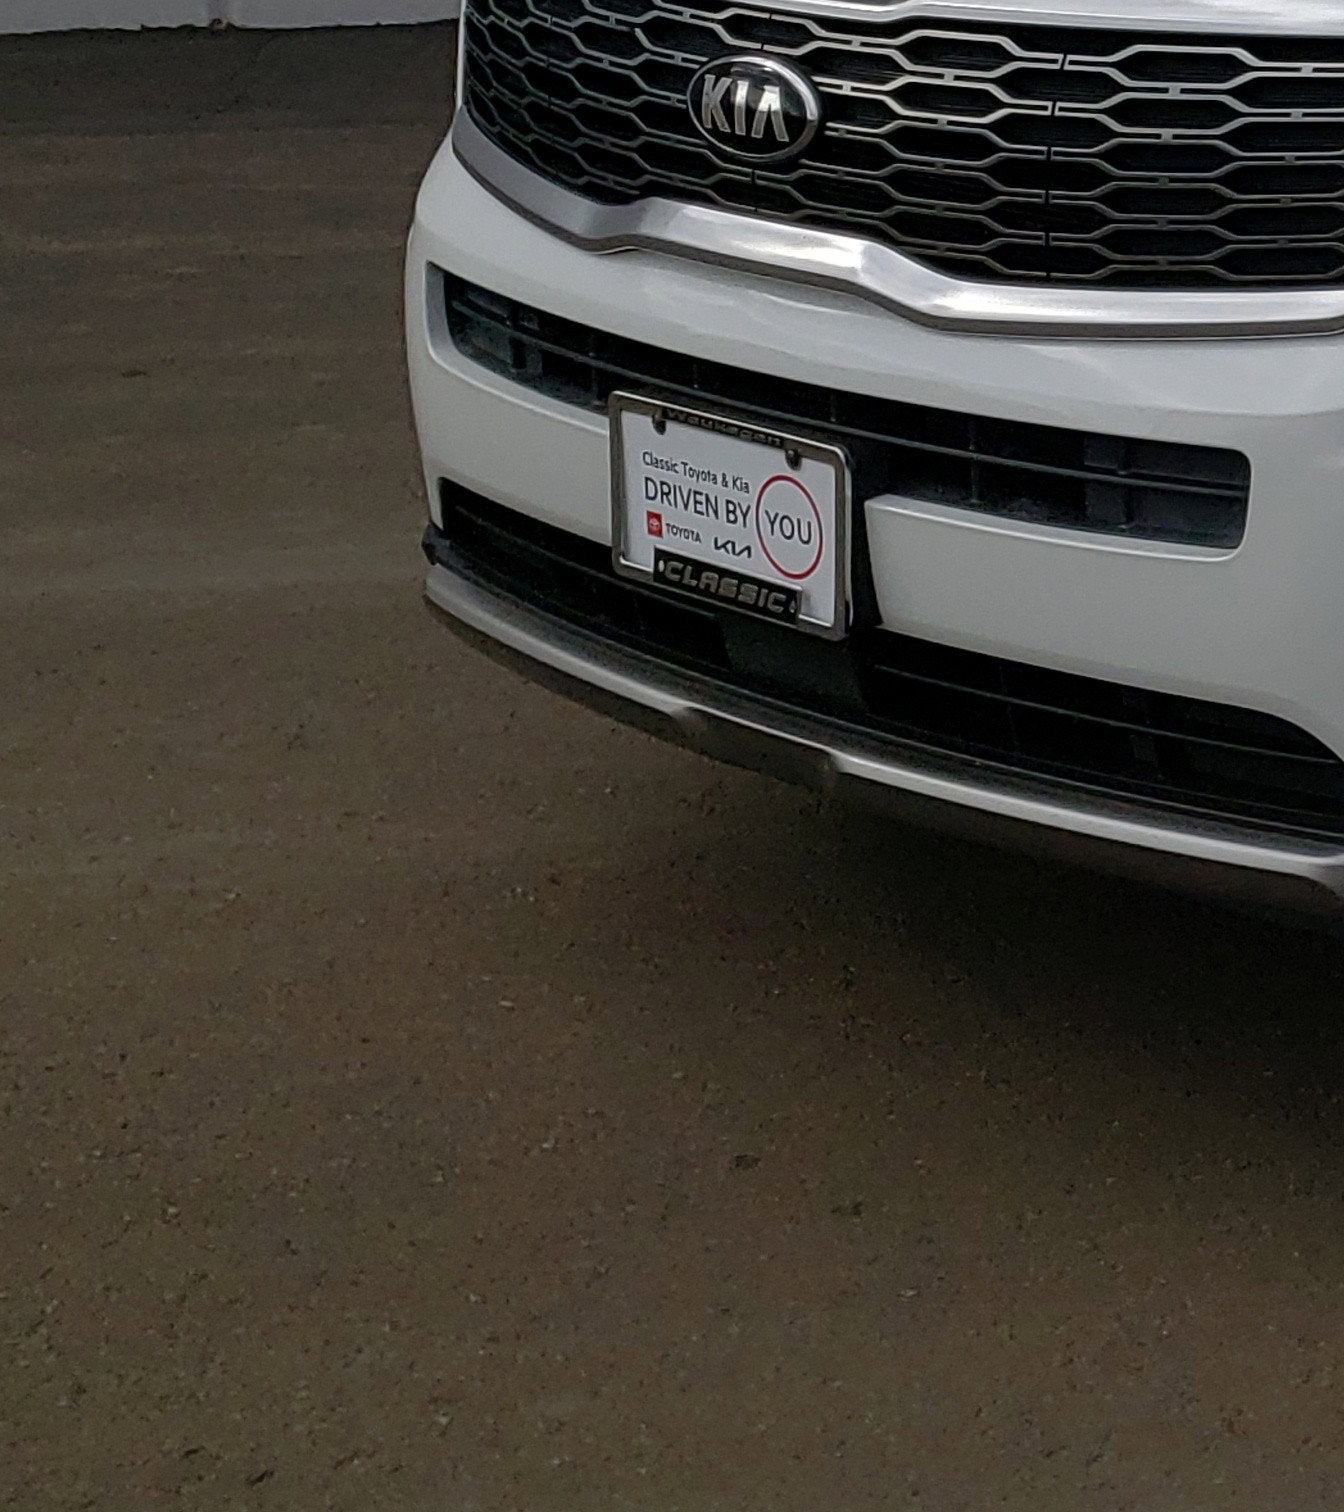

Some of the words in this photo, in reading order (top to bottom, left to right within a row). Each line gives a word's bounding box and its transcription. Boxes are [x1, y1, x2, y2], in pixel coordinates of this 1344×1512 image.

[702, 73, 790, 143] KIA
[642, 450, 680, 474] Classic
[681, 462, 717, 485] Toyota
[721, 473, 728, 488] &
[732, 475, 750, 494] Kia
[644, 476, 719, 520] DRIVEN
[725, 499, 751, 529] BY
[764, 509, 812, 545] YOU
[665, 522, 702, 543] TOYOTA
[664, 561, 787, 614] CLASSIC
